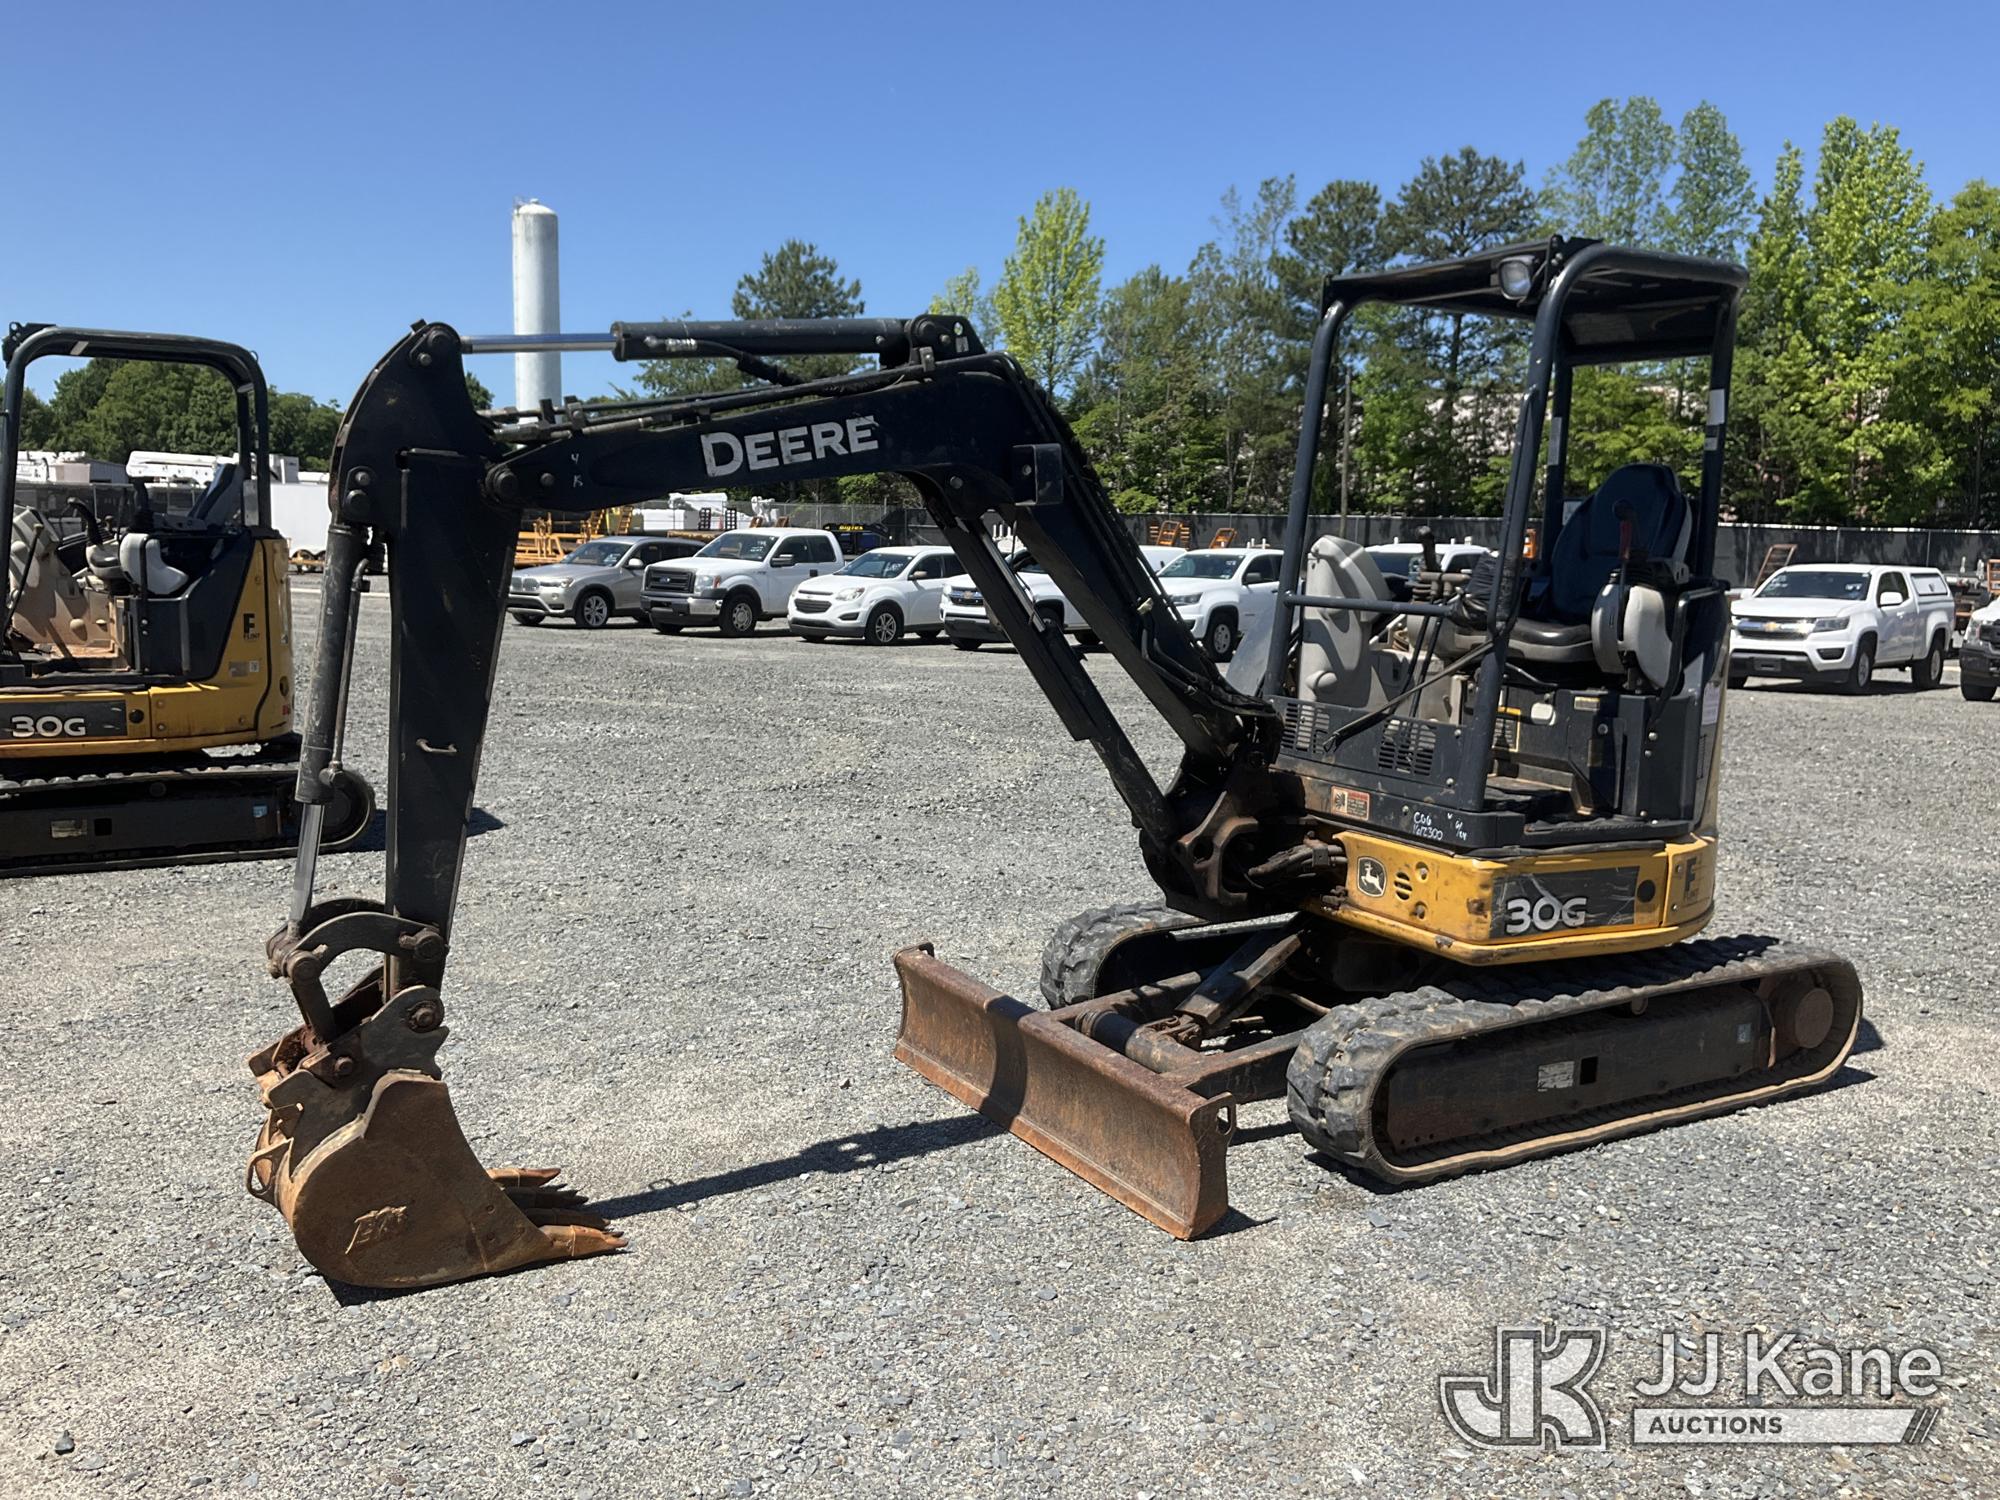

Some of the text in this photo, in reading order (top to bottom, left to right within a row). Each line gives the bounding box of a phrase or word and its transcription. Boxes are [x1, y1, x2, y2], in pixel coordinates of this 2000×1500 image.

[700, 415, 879, 478] DEERE
[243, 613, 256, 634] F
[11, 715, 87, 738] 30G
[1506, 896, 1588, 935] 30G
